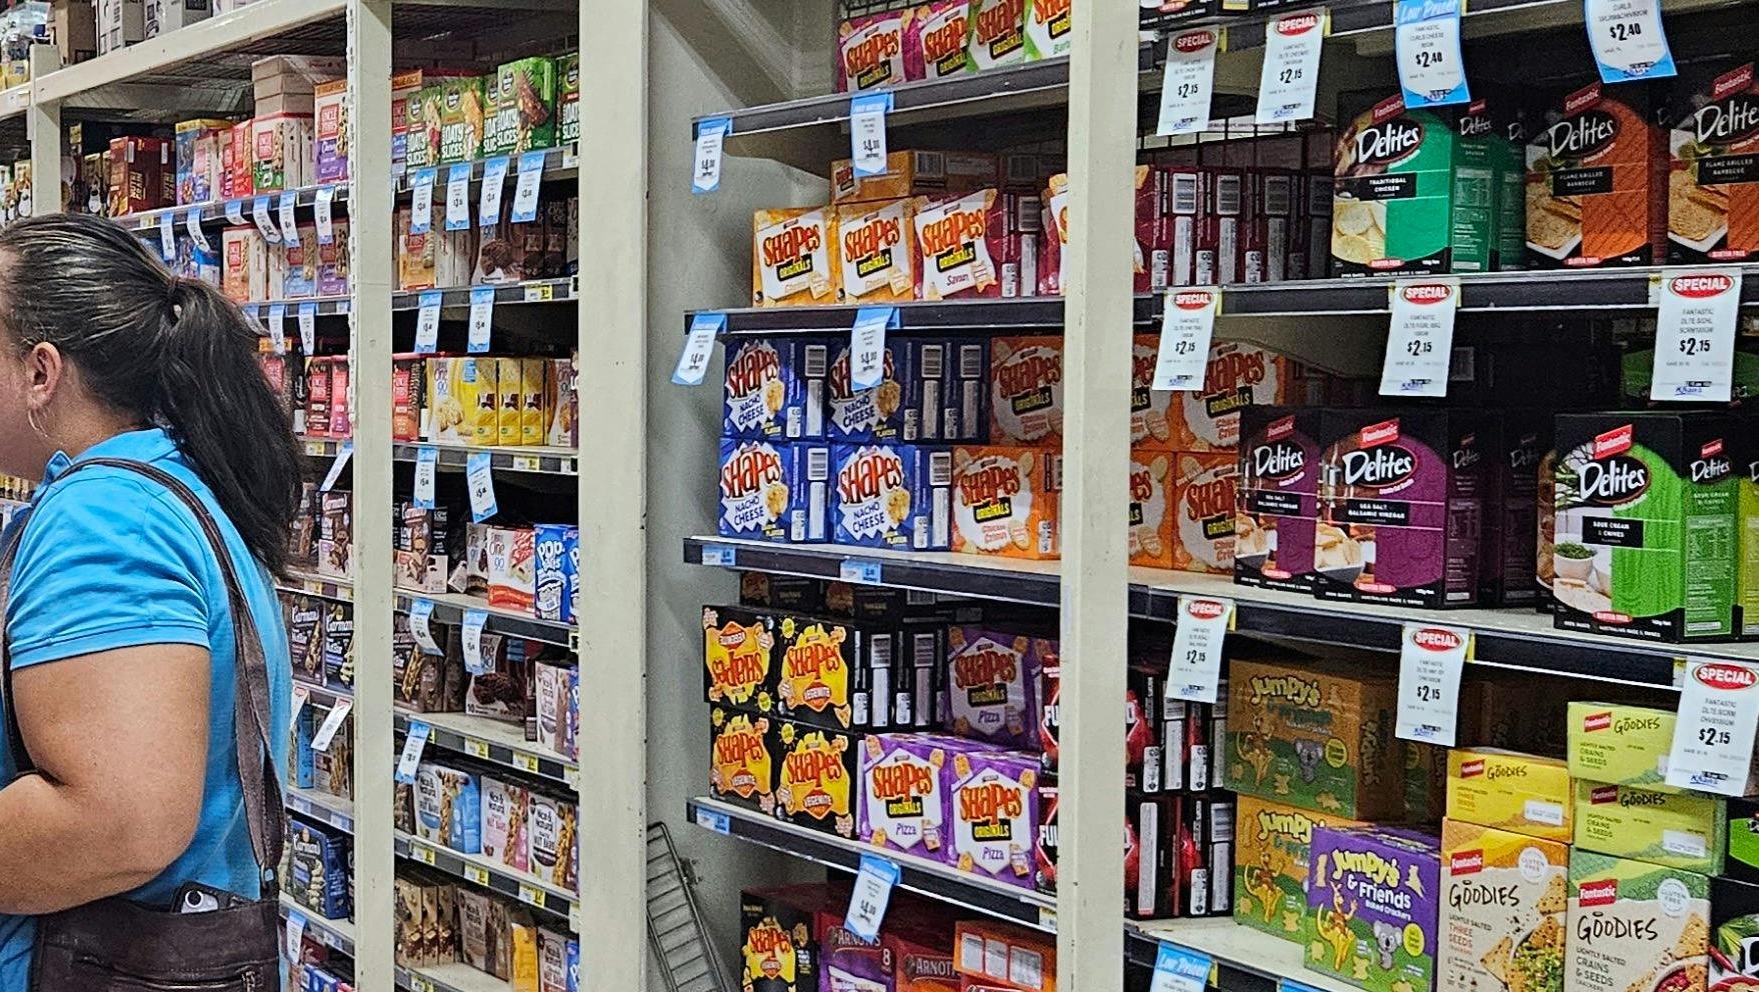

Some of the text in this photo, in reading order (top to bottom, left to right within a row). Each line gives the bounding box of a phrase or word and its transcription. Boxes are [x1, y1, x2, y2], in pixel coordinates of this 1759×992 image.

[1277, 14, 1318, 33] SPECIAL
[1609, 23, 1642, 42] $2.40
[1176, 33, 1213, 48] SPECIAL
[1415, 51, 1443, 68] $2.40
[1279, 68, 1303, 85] $2.15
[1177, 83, 1199, 99] $2.15
[1694, 100, 1759, 144] Delite
[1356, 120, 1419, 161] Delites
[1548, 115, 1615, 158] Delites
[1404, 285, 1449, 300] SPECIAL
[1674, 276, 1728, 293] SPECIAL
[1175, 292, 1210, 306] SPECIAL
[1174, 339, 1196, 355] $2.15
[1407, 339, 1433, 356] $2.15
[1679, 337, 1711, 356] $2.15
[739, 394, 763, 413] NACHO
[844, 394, 871, 414] NACHO
[737, 403, 765, 427] CHEESE
[842, 404, 876, 428] CHEESE
[1254, 446, 1305, 477] Delites
[1342, 450, 1413, 486] Delites
[1690, 458, 1731, 483] Delites
[1577, 459, 1646, 500] Delites
[735, 496, 760, 514] NACHO
[853, 503, 881, 521] NACHO
[734, 506, 765, 527] CHEESE
[852, 512, 886, 533] CHEESE
[1190, 602, 1224, 617] SPECIAL
[1414, 631, 1459, 648] SPECIAL
[1186, 649, 1207, 664] $2.15
[1697, 666, 1755, 689] SPECIAL
[1417, 684, 1441, 703] $2.15
[1698, 727, 1731, 746] $2.15
[895, 822, 918, 837] Pizza
[981, 846, 1005, 862] Pizza
[1452, 856, 1483, 875] Fantastic
[1346, 876, 1411, 909] & Friends
[1579, 884, 1617, 904] Fantastic
[1448, 923, 1474, 939] THREE
[1448, 933, 1473, 951] SEEDS
[881, 947, 892, 968] 8
[1159, 953, 1209, 977] Low Prices
[1576, 957, 1609, 974] GRAINS
[1584, 970, 1614, 987] SEEDS
